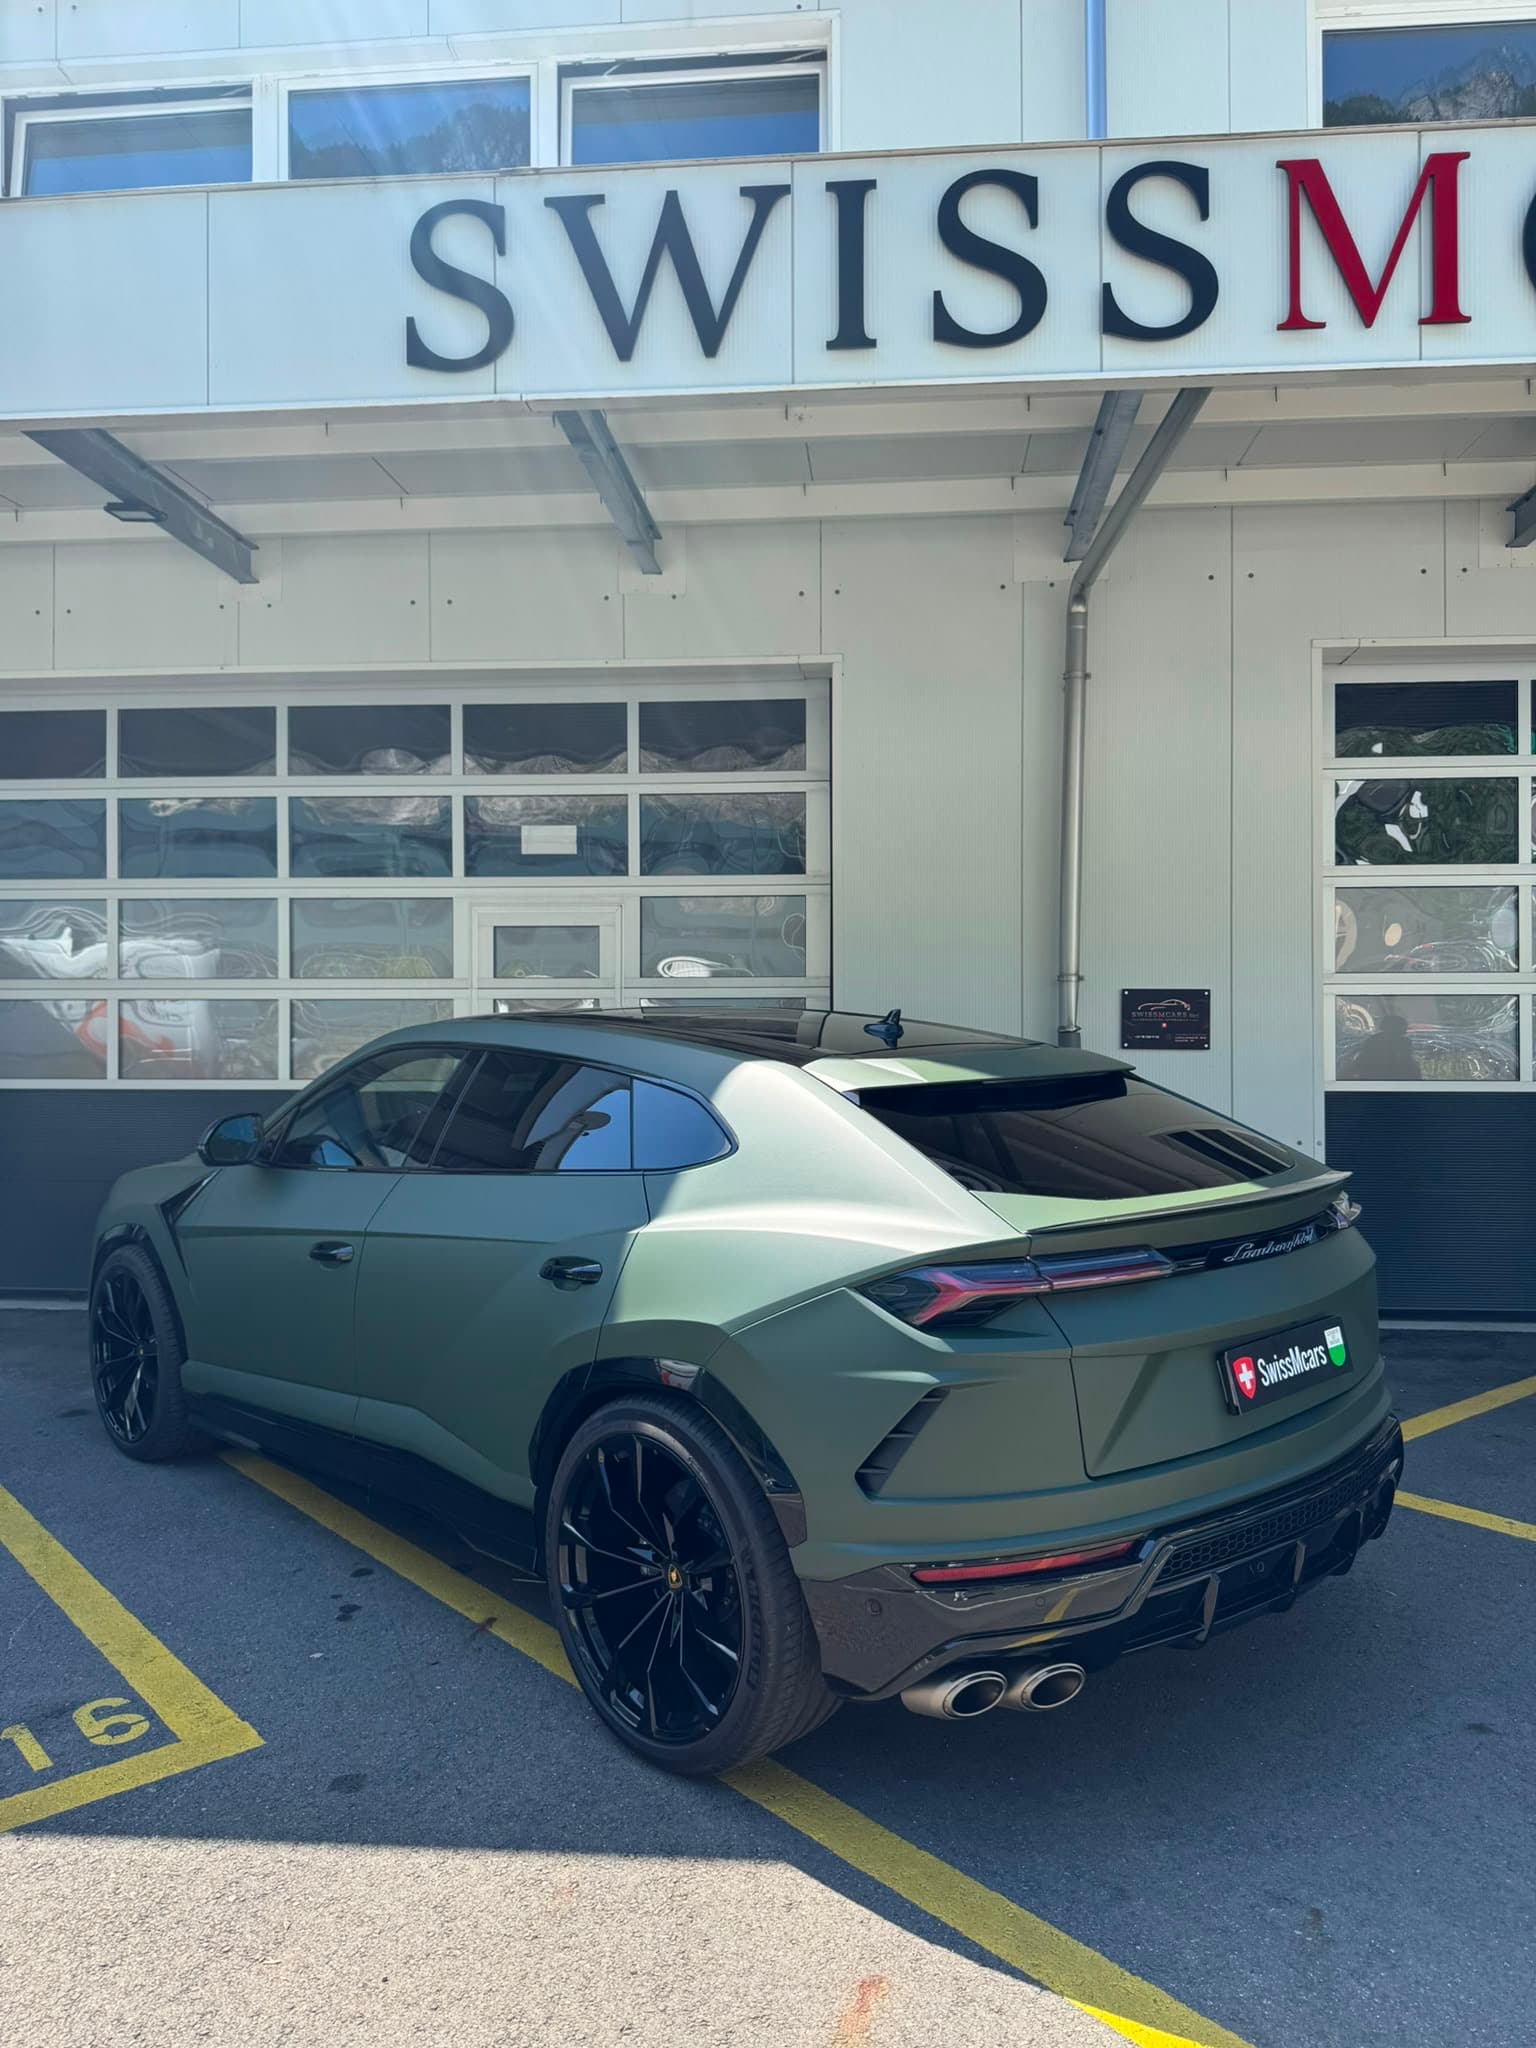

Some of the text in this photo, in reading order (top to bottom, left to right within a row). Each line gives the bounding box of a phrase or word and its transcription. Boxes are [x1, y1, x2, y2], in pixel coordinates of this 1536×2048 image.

[406, 151, 1536, 372] SWISSM
[1257, 1344, 1328, 1387] SwissMcars
[0, 1697, 150, 1771] 16
